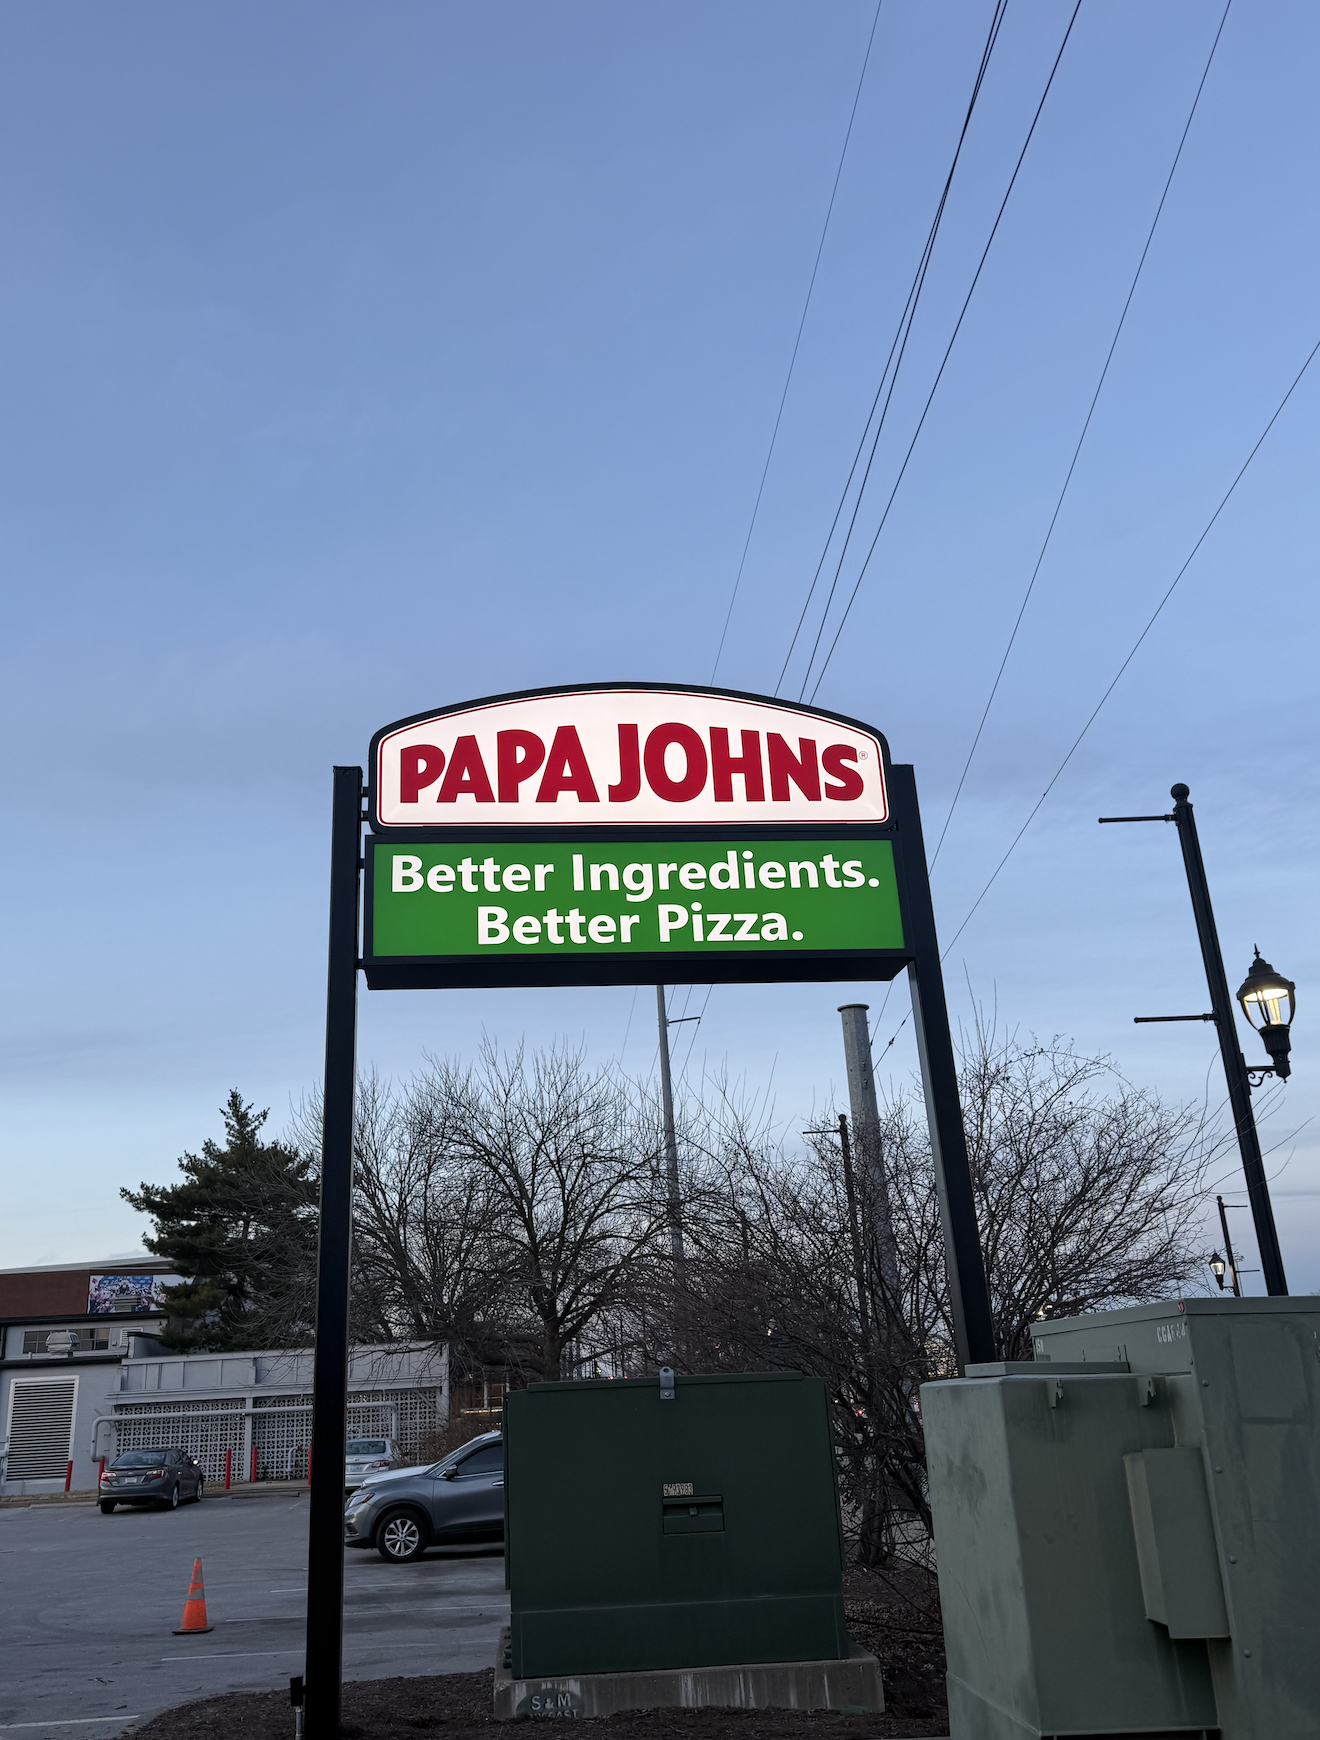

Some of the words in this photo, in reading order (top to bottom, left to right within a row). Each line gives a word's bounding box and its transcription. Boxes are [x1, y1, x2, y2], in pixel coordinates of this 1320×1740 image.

[400, 725, 600, 804] PAPA
[608, 722, 865, 804] JOHNS
[391, 854, 554, 893] Better
[572, 850, 880, 902] Ingredients.
[477, 906, 640, 945] Better
[657, 902, 804, 943] Pizza.
[531, 1695, 541, 1710] S
[544, 1698, 554, 1709] &
[557, 1693, 571, 1707] M
